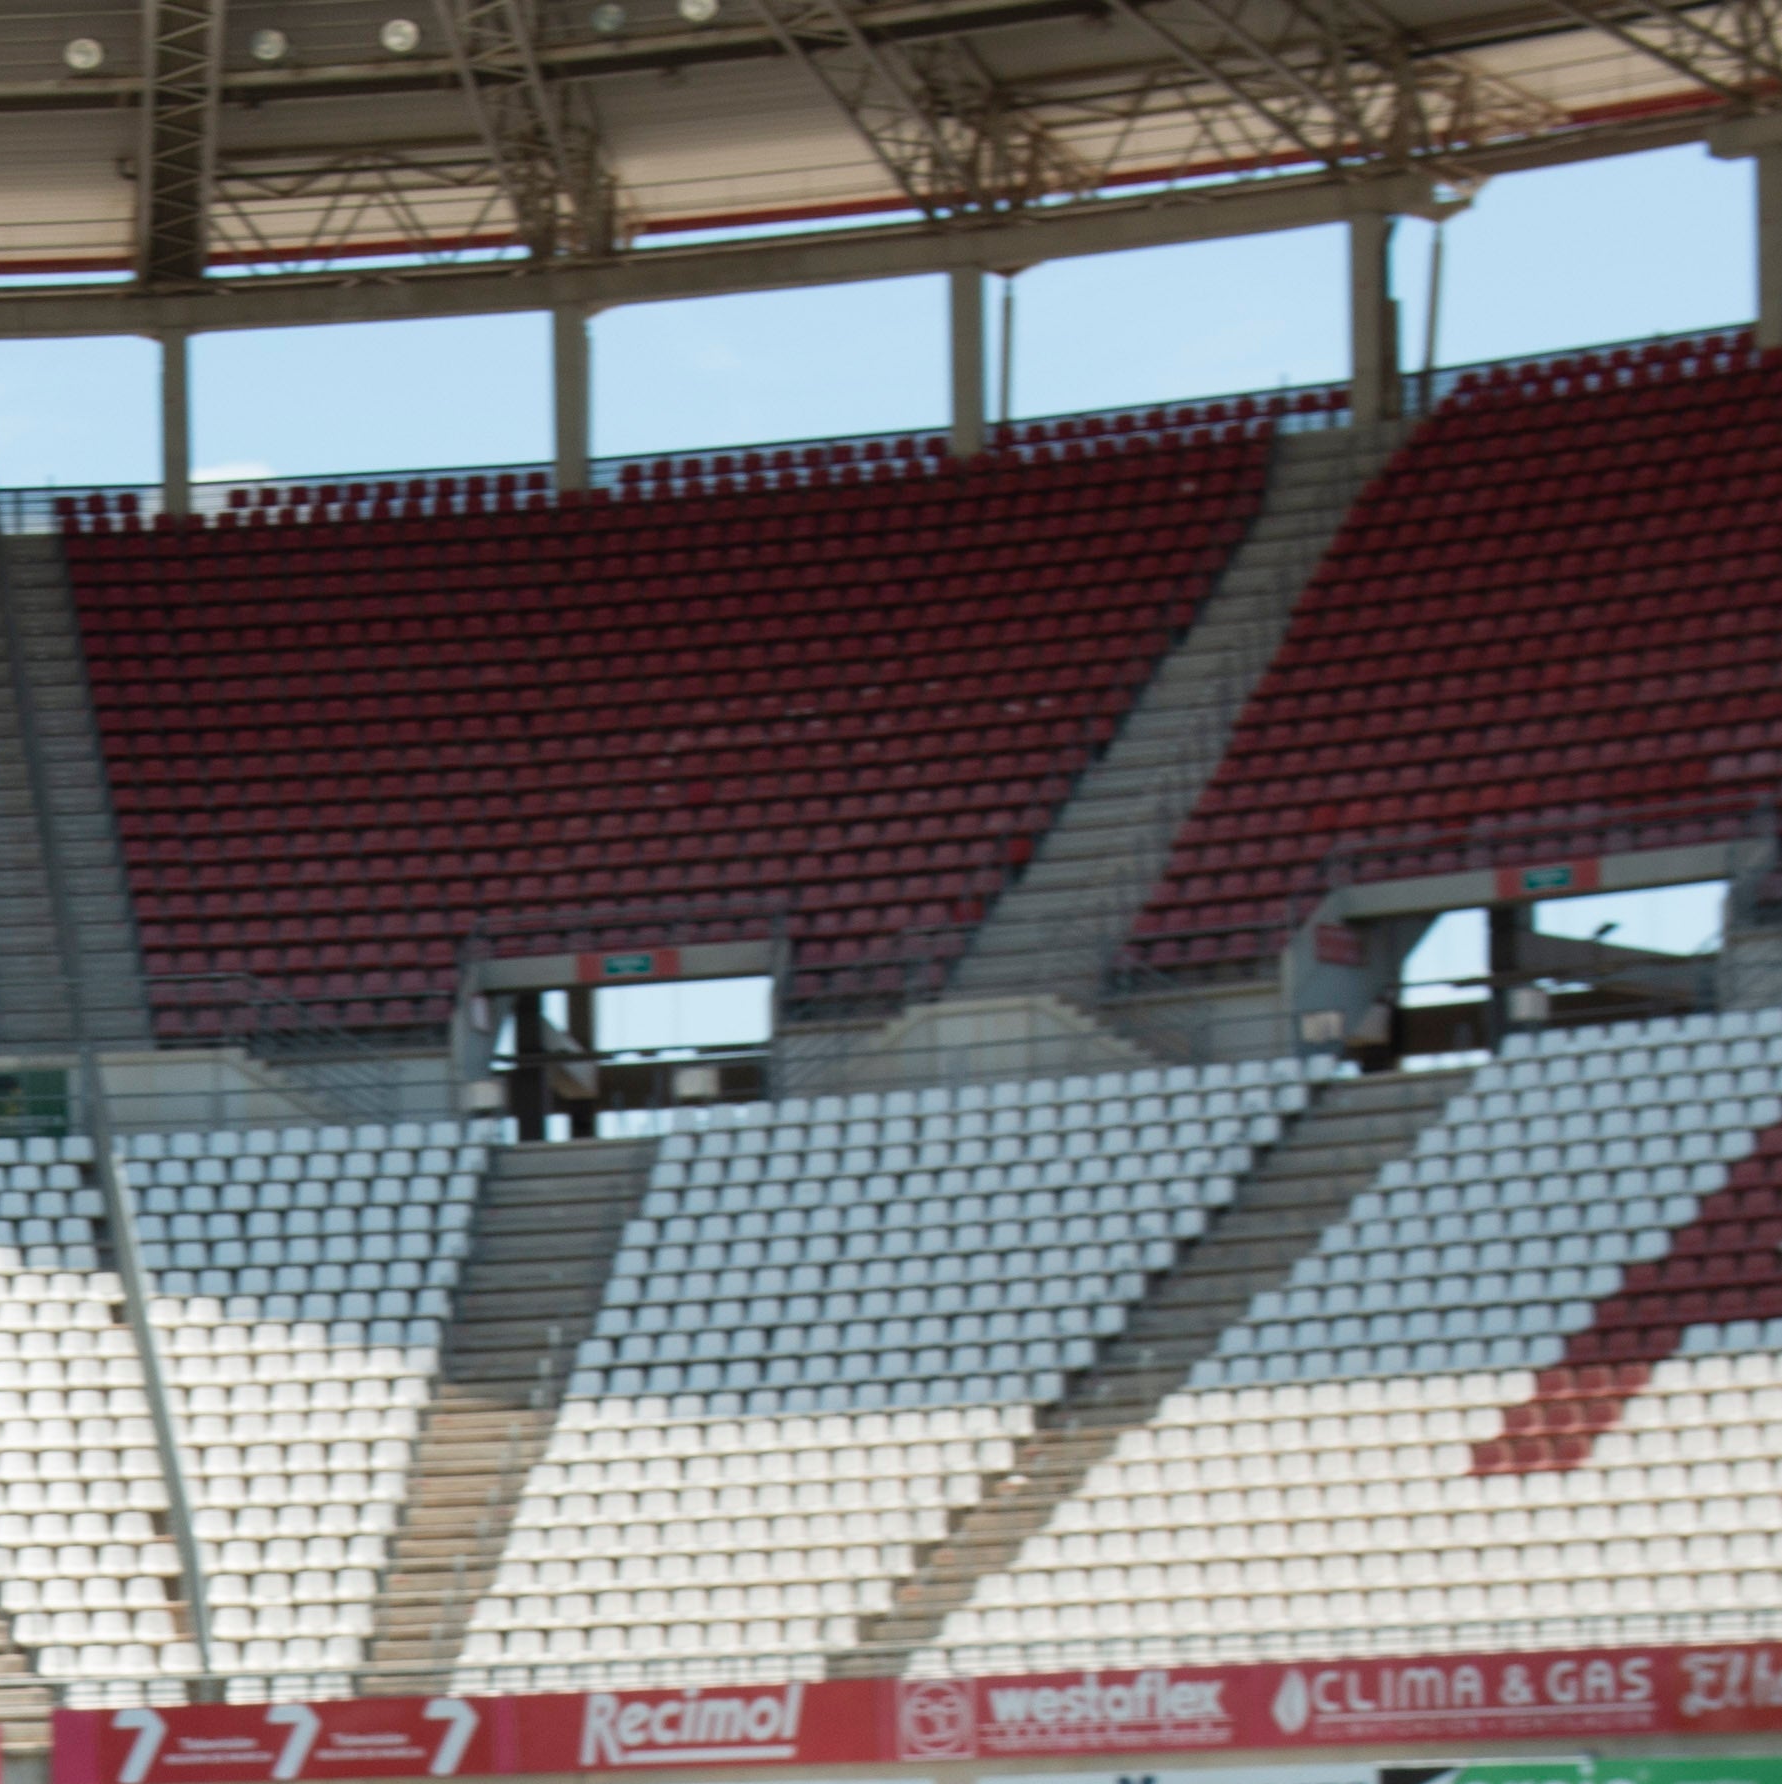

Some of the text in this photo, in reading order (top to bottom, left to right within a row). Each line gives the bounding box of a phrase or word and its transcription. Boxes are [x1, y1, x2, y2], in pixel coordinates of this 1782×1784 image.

[1312, 1656, 1654, 1713] CLIMA & GAS
[112, 1708, 168, 1784] 7
[265, 1703, 321, 1780] 7
[422, 1697, 479, 1777] 7
[580, 1684, 803, 1766] Recimol
